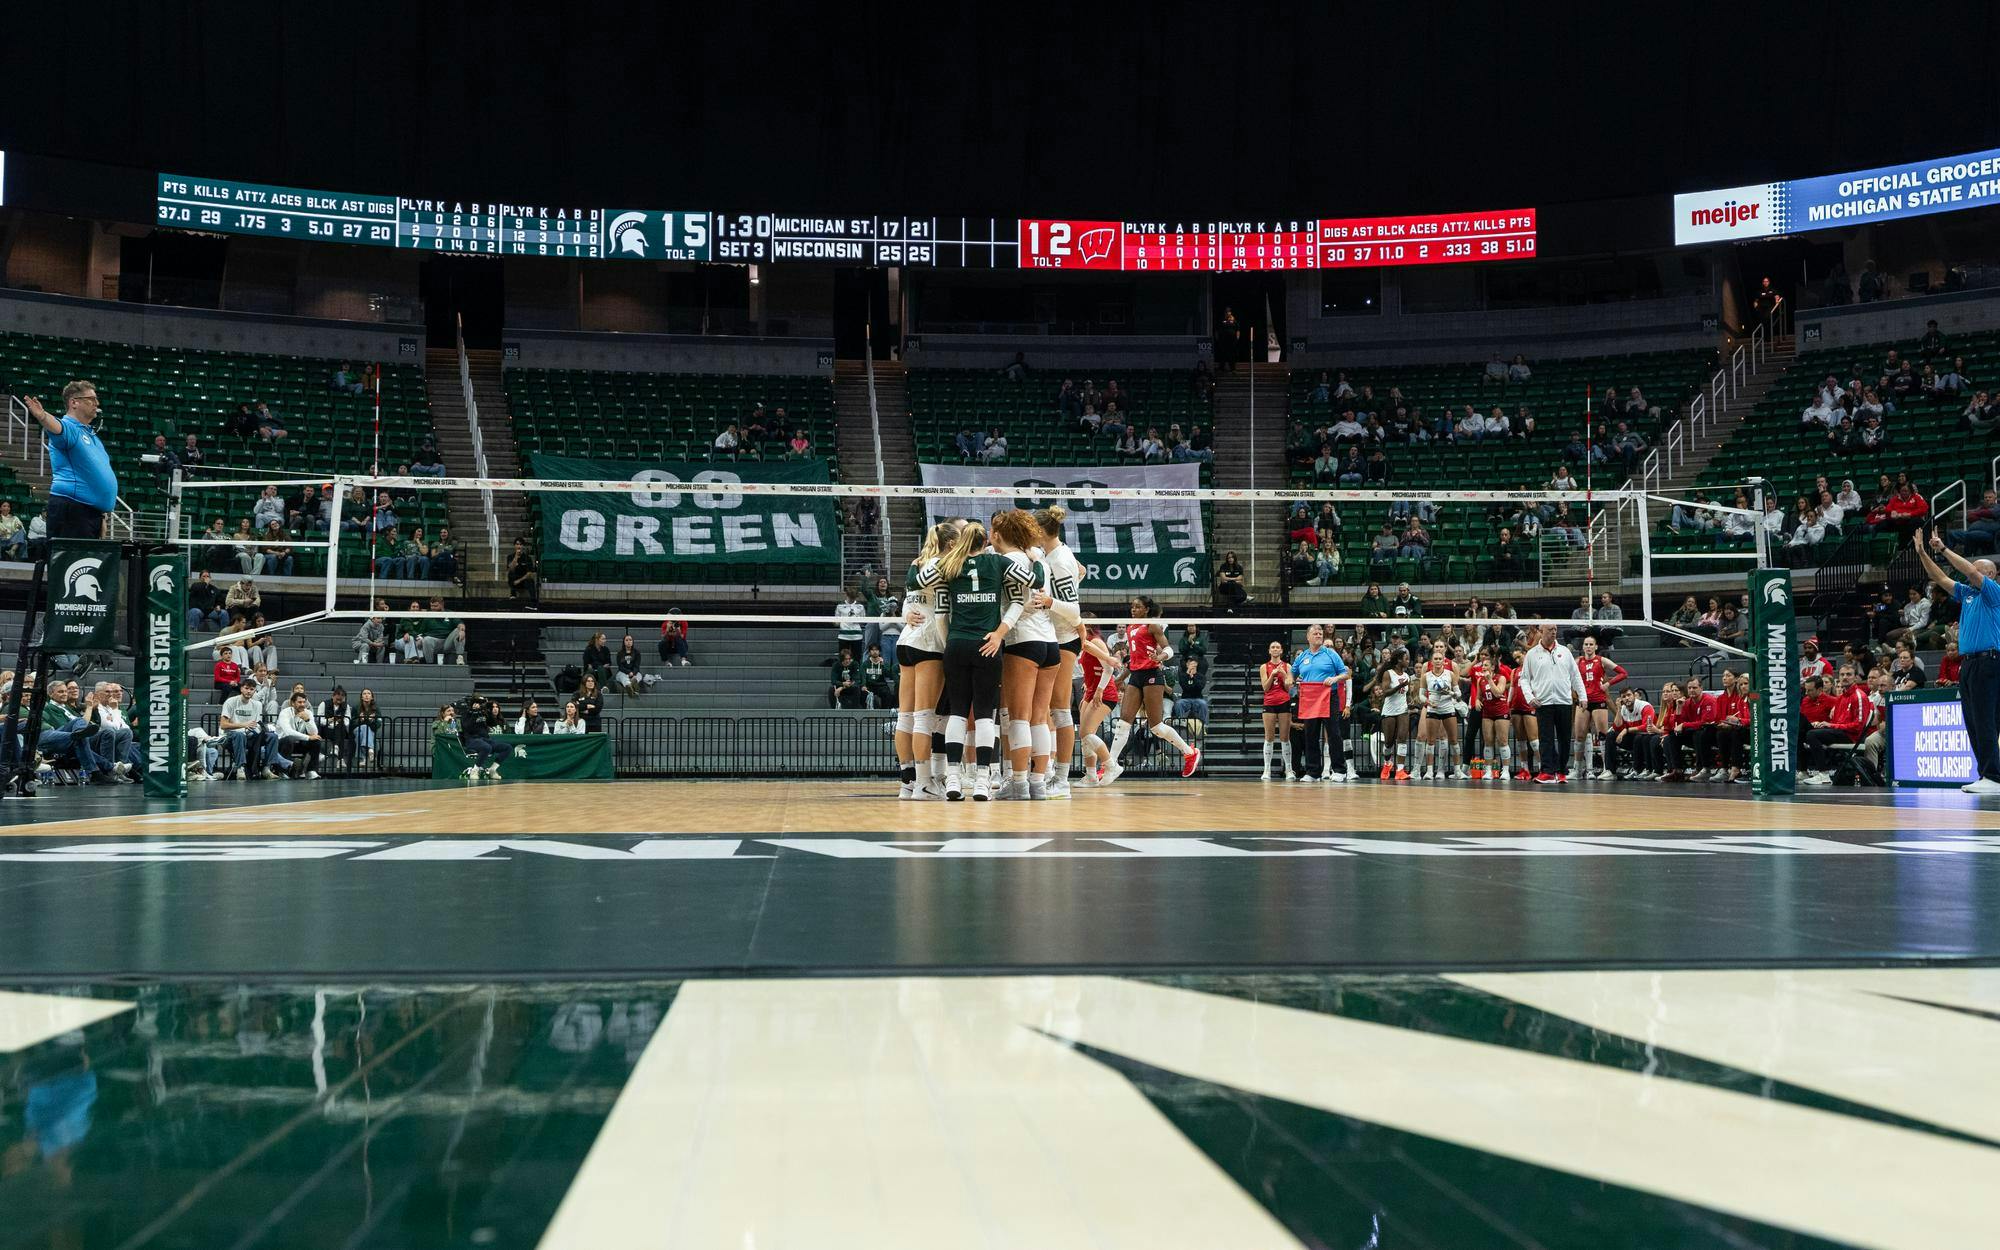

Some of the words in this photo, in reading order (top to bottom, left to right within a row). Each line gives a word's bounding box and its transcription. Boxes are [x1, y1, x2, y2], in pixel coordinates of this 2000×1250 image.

[1838, 172, 1922, 198] OFFICIAL
[164, 182, 186, 194] PTS
[194, 185, 228, 198] KILLS
[236, 190, 266, 202] ATT%
[271, 194, 301, 206] ACES
[307, 197, 336, 209] BLCK
[342, 200, 364, 212] AST
[368, 203, 394, 214] DIGS
[1808, 197, 1902, 222] MICHIGAN
[1908, 186, 1962, 208] STATE
[1968, 179, 2000, 199] ATH
[402, 199, 432, 211] PLYR
[437, 201, 444, 212] K
[454, 203, 462, 213] A
[472, 204, 479, 214] B
[489, 205, 495, 215] D
[504, 206, 533, 217] PLYR
[540, 208, 547, 218] K
[558, 208, 566, 218] A
[574, 209, 581, 219] B
[591, 210, 598, 220] D
[1691, 200, 1760, 228] meijer
[159, 206, 190, 220] 37.0
[201, 210, 220, 224] 29
[235, 214, 265, 229] .175
[282, 218, 290, 231] 3
[309, 221, 333, 235] 5.0
[343, 224, 362, 237] 27
[371, 226, 390, 240] 20
[415, 212, 418, 222] 1
[436, 214, 443, 224] 0
[454, 215, 460, 225] 2
[471, 216, 478, 226] 0
[488, 217, 495, 227] 6
[516, 219, 522, 228] 9
[540, 220, 547, 230] 5
[557, 221, 564, 230] 0
[576, 221, 580, 231] 1
[590, 222, 597, 232] 2
[717, 215, 770, 237] 1:30
[775, 219, 844, 233] MICHIGAN
[851, 220, 873, 234] ST.
[883, 222, 899, 236] 17
[911, 222, 928, 236] 21
[1127, 223, 1155, 233] PLYR
[1159, 224, 1166, 233] K
[1176, 224, 1183, 233] A
[1193, 224, 1199, 233] B
[1209, 224, 1215, 233] D
[1223, 223, 1251, 233] PLYR
[1258, 223, 1265, 232] K
[1275, 222, 1282, 232] A
[1291, 222, 1297, 232] B
[1307, 222, 1313, 231] D
[1324, 228, 1348, 238] DIGS
[1352, 226, 1373, 236] AST
[1378, 225, 1405, 235] BLCK
[1410, 224, 1437, 234] ACES
[1442, 221, 1470, 232] ATT%
[1474, 219, 1505, 230] KILLS
[1510, 217, 1530, 228] PTS
[662, 214, 706, 246] 15
[1029, 222, 1070, 255] 12
[1234, 235, 1244, 244] 17
[1259, 234, 1264, 244] 1
[1274, 234, 1281, 244] 0
[1292, 234, 1296, 244] 1
[1306, 233, 1313, 243] 0
[412, 237, 419, 247] 7
[435, 239, 442, 249] 0
[451, 240, 463, 250] 14
[470, 241, 477, 251] 0
[488, 242, 494, 252] 2
[1141, 235, 1144, 245] 1
[1159, 235, 1165, 245] 9
[1177, 235, 1183, 245] 2
[1194, 235, 1198, 245] 1
[1209, 235, 1215, 245] 5
[513, 243, 525, 254] 14
[540, 245, 546, 255] 9
[557, 245, 564, 255] 0
[576, 246, 579, 256] 1
[590, 247, 597, 257] 2
[666, 249, 686, 259] TOL
[688, 250, 695, 260] 2
[720, 242, 750, 257] SET
[754, 243, 763, 257] 3
[775, 242, 862, 258] WISCONSIN
[880, 246, 900, 260] 25
[909, 246, 930, 261] 25
[1328, 249, 1344, 261] 30
[1354, 248, 1371, 260] 37
[1380, 246, 1403, 259] 11.0
[1420, 245, 1428, 257] 2
[1443, 244, 1470, 256] .333
[1482, 241, 1498, 254] 38
[1507, 239, 1534, 252] 51.0
[1033, 257, 1052, 266] TOL
[1055, 258, 1061, 267] 2
[1137, 259, 1147, 269] 10
[1161, 259, 1164, 269] 1
[1179, 259, 1182, 269] 1
[1193, 259, 1199, 269] 0
[1209, 259, 1215, 269] 0
[1232, 259, 1246, 269] 24
[1260, 259, 1263, 268] 1
[1271, 258, 1284, 268] 30
[1291, 258, 1297, 268] 3
[1307, 257, 1313, 267] 5
[1806, 330, 1819, 338] 104
[400, 344, 416, 352] 135
[559, 509, 822, 555] GREEN
[967, 568, 980, 592] 1
[957, 593, 996, 603] SCHNEIDER
[55, 604, 86, 612] MICHIGAN
[64, 623, 94, 635] meijer
[150, 612, 170, 670] STATE
[1768, 624, 1787, 714] MICHIGAN
[1922, 704, 1962, 726] MICHIGAN
[149, 676, 170, 773] MICHIGAN
[1770, 718, 1790, 772] STATE
[1915, 730, 1971, 752] ACHIEVEMENT
[1917, 756, 1972, 778] SCHOLARSHIP
